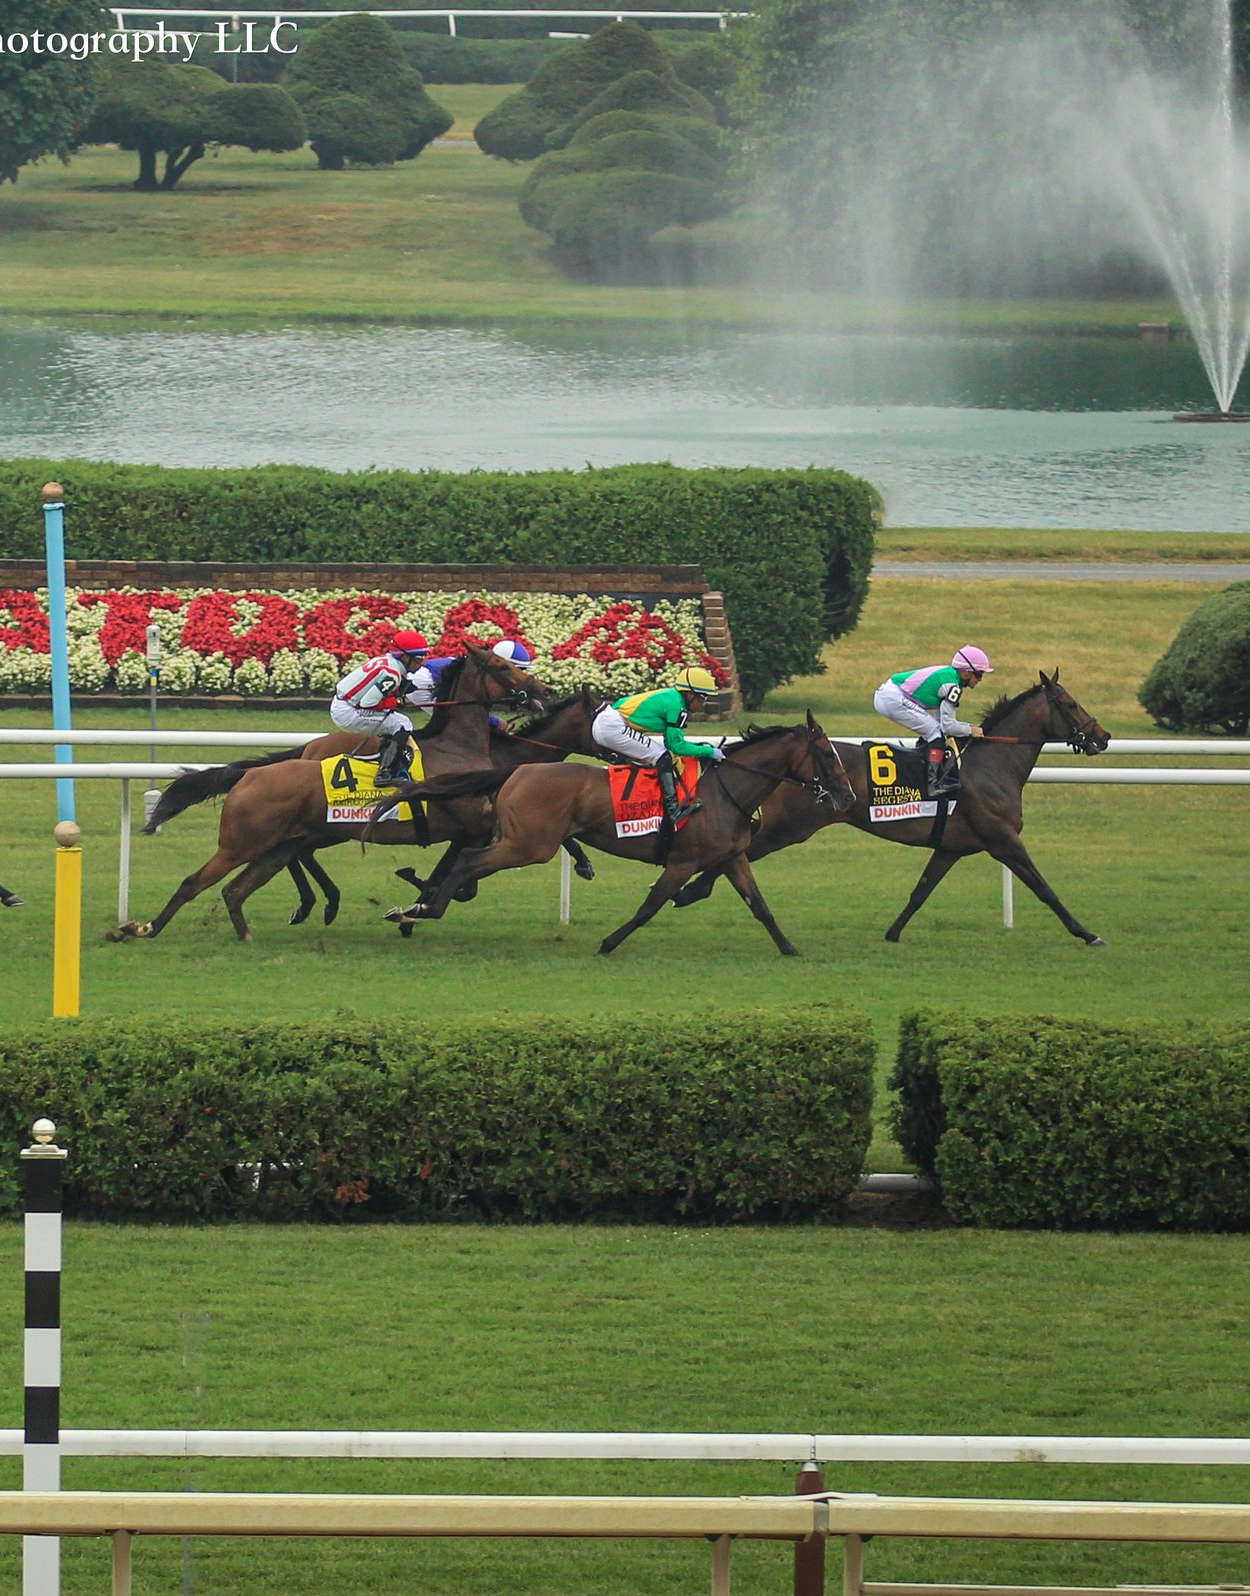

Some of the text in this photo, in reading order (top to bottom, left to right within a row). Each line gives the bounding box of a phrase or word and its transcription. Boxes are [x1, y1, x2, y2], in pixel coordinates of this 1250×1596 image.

[381, 681, 394, 692] 4
[948, 687, 960, 702] 6
[680, 712, 688, 727] 7
[869, 745, 897, 785] 6
[331, 758, 358, 792] 4
[614, 767, 640, 800] 7
[873, 786, 894, 796] THE
[873, 794, 922, 805] SEGESTA
